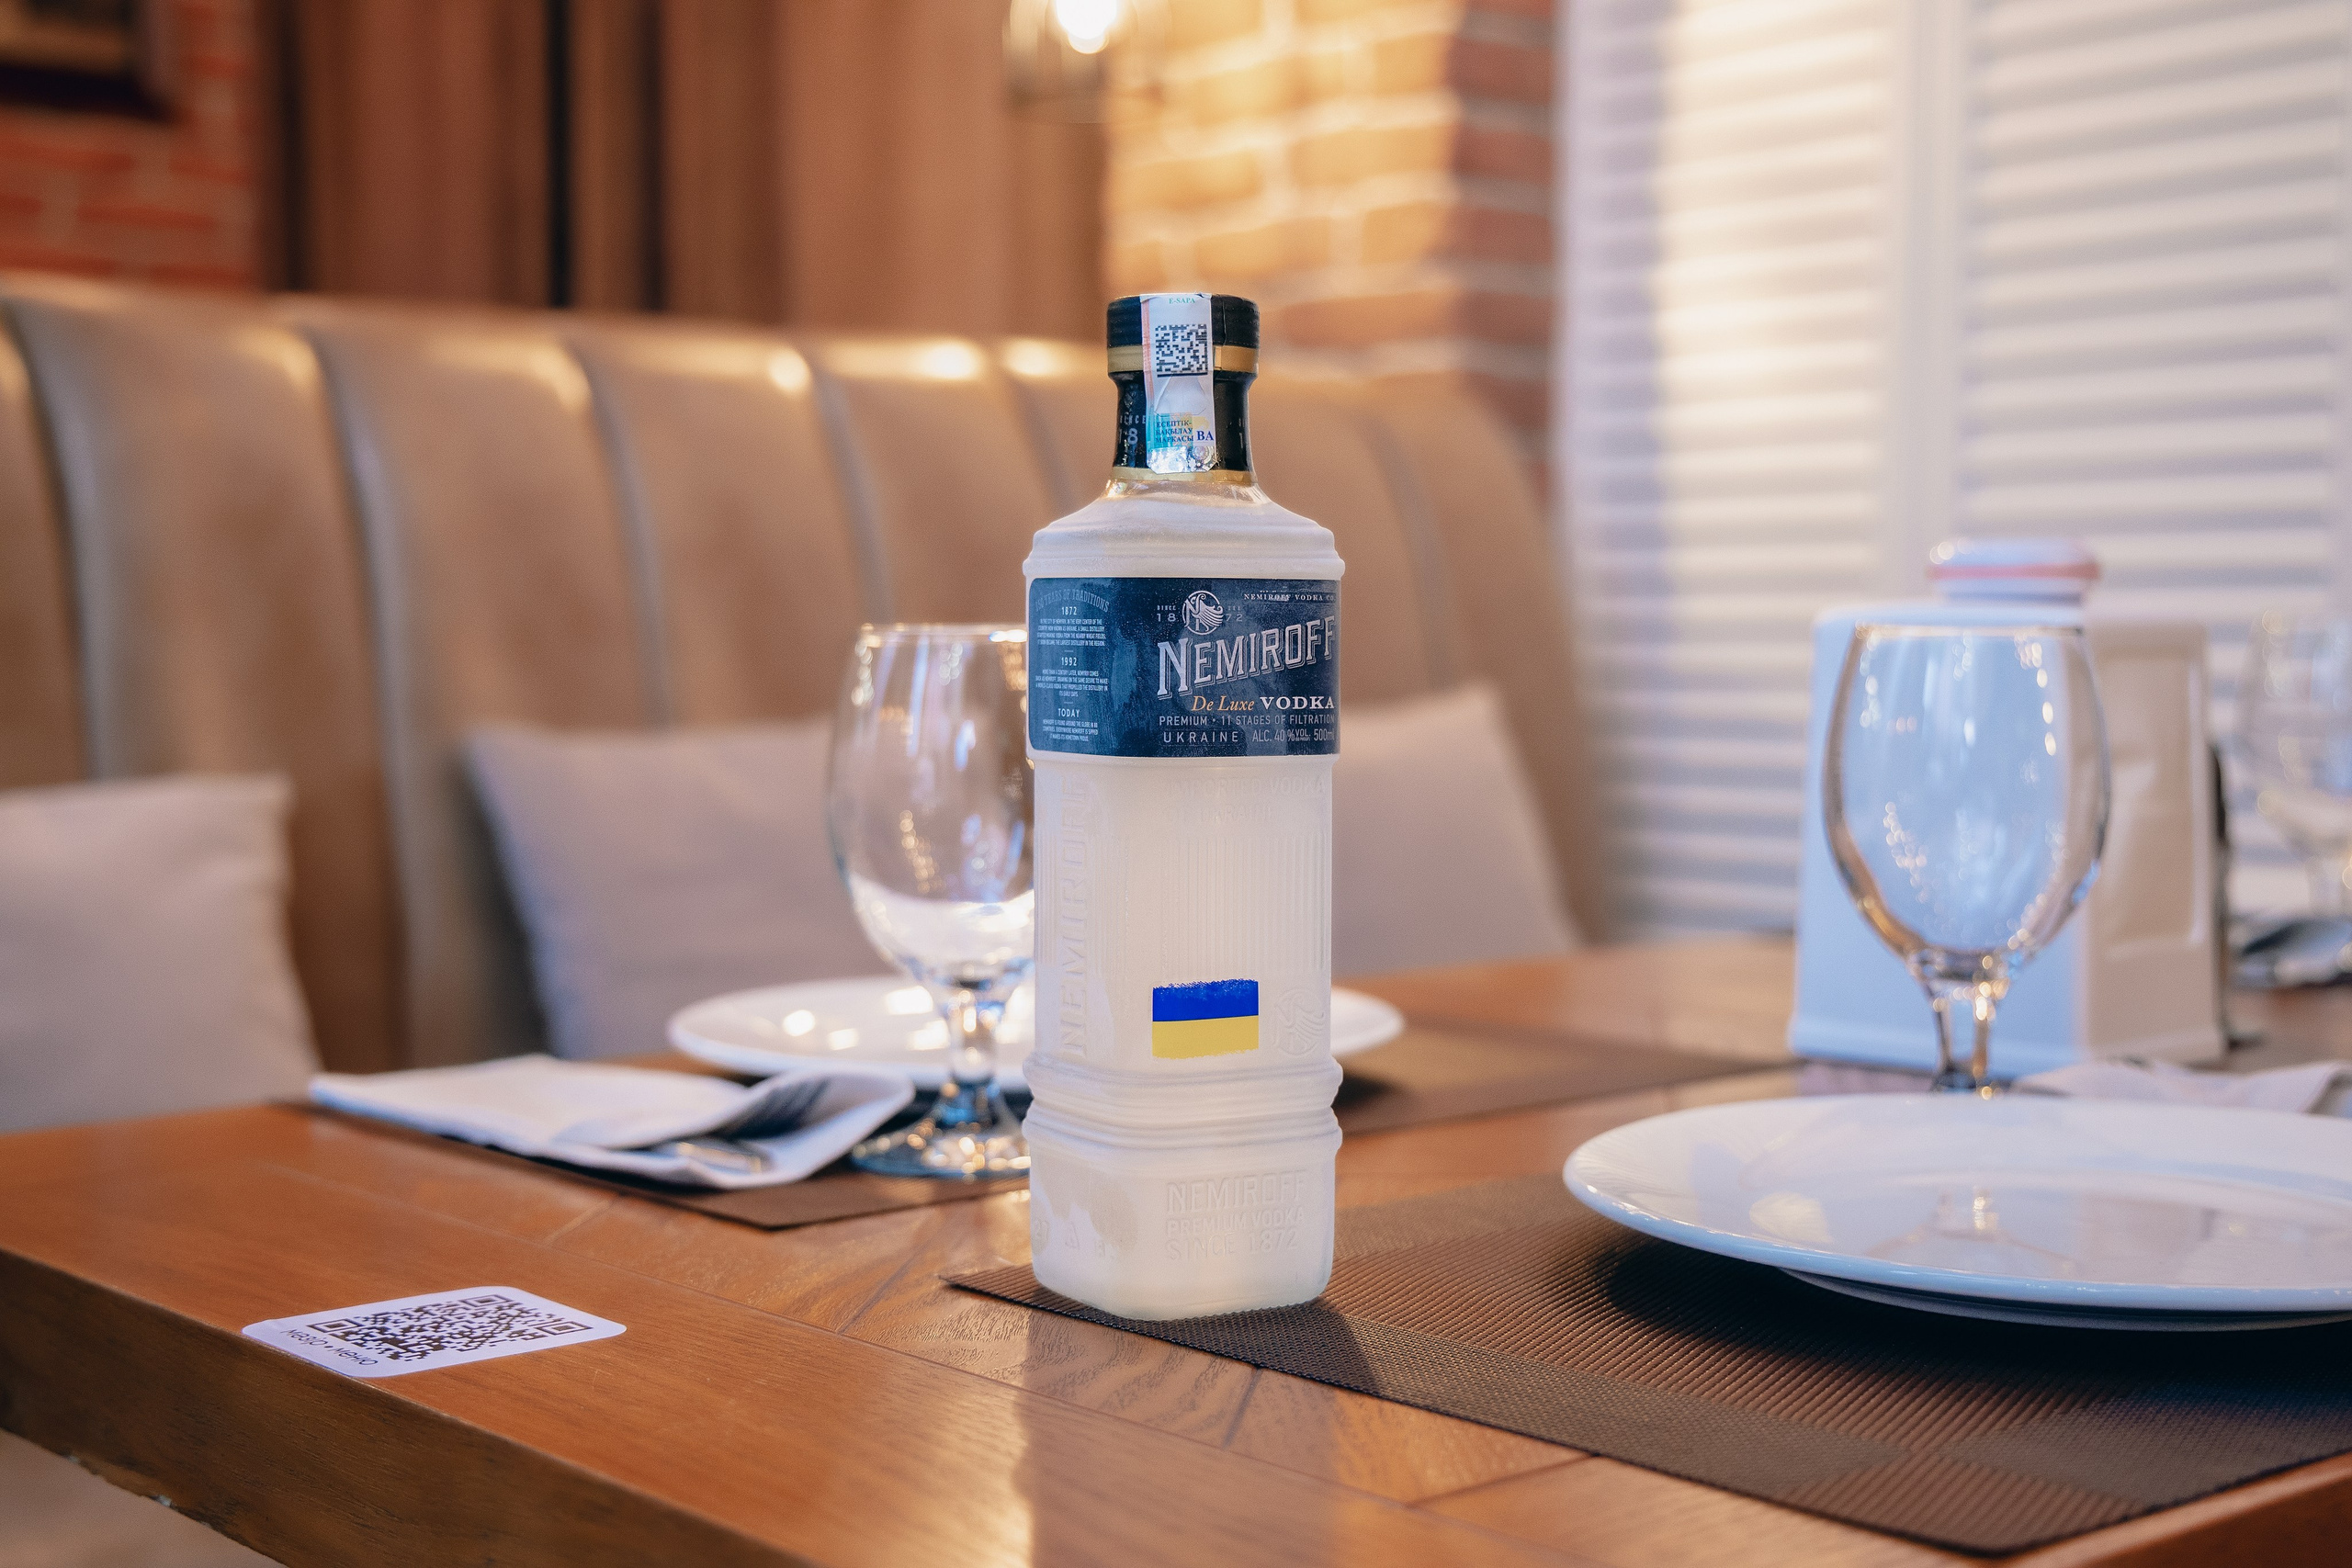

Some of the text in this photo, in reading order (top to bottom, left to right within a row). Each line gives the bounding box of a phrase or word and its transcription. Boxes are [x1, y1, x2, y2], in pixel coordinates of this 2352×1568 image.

[1072, 589, 1110, 613] TRADITIONS
[1244, 593, 1291, 602] NEMIROFF
[1295, 593, 1323, 602] VODKA
[1061, 606, 1078, 615] 1872
[1061, 657, 1078, 666] 1992
[1157, 615, 1336, 701] NEMIROFF
[1191, 695, 1335, 711] De Luxe VODKA
[1057, 707, 1080, 717] TODAY
[1159, 714, 1336, 727] PREMIUM 11 STAGES OF FILTRATION
[1162, 730, 1238, 743] UKRAINE
[1252, 728, 1272, 742] ALC.
[1166, 1169, 1307, 1215] NEMIROFF
[1252, 1205, 1304, 1228] VODKA
[1165, 1225, 1297, 1262] SINCE 1872
[327, 1348, 379, 1365] меню
